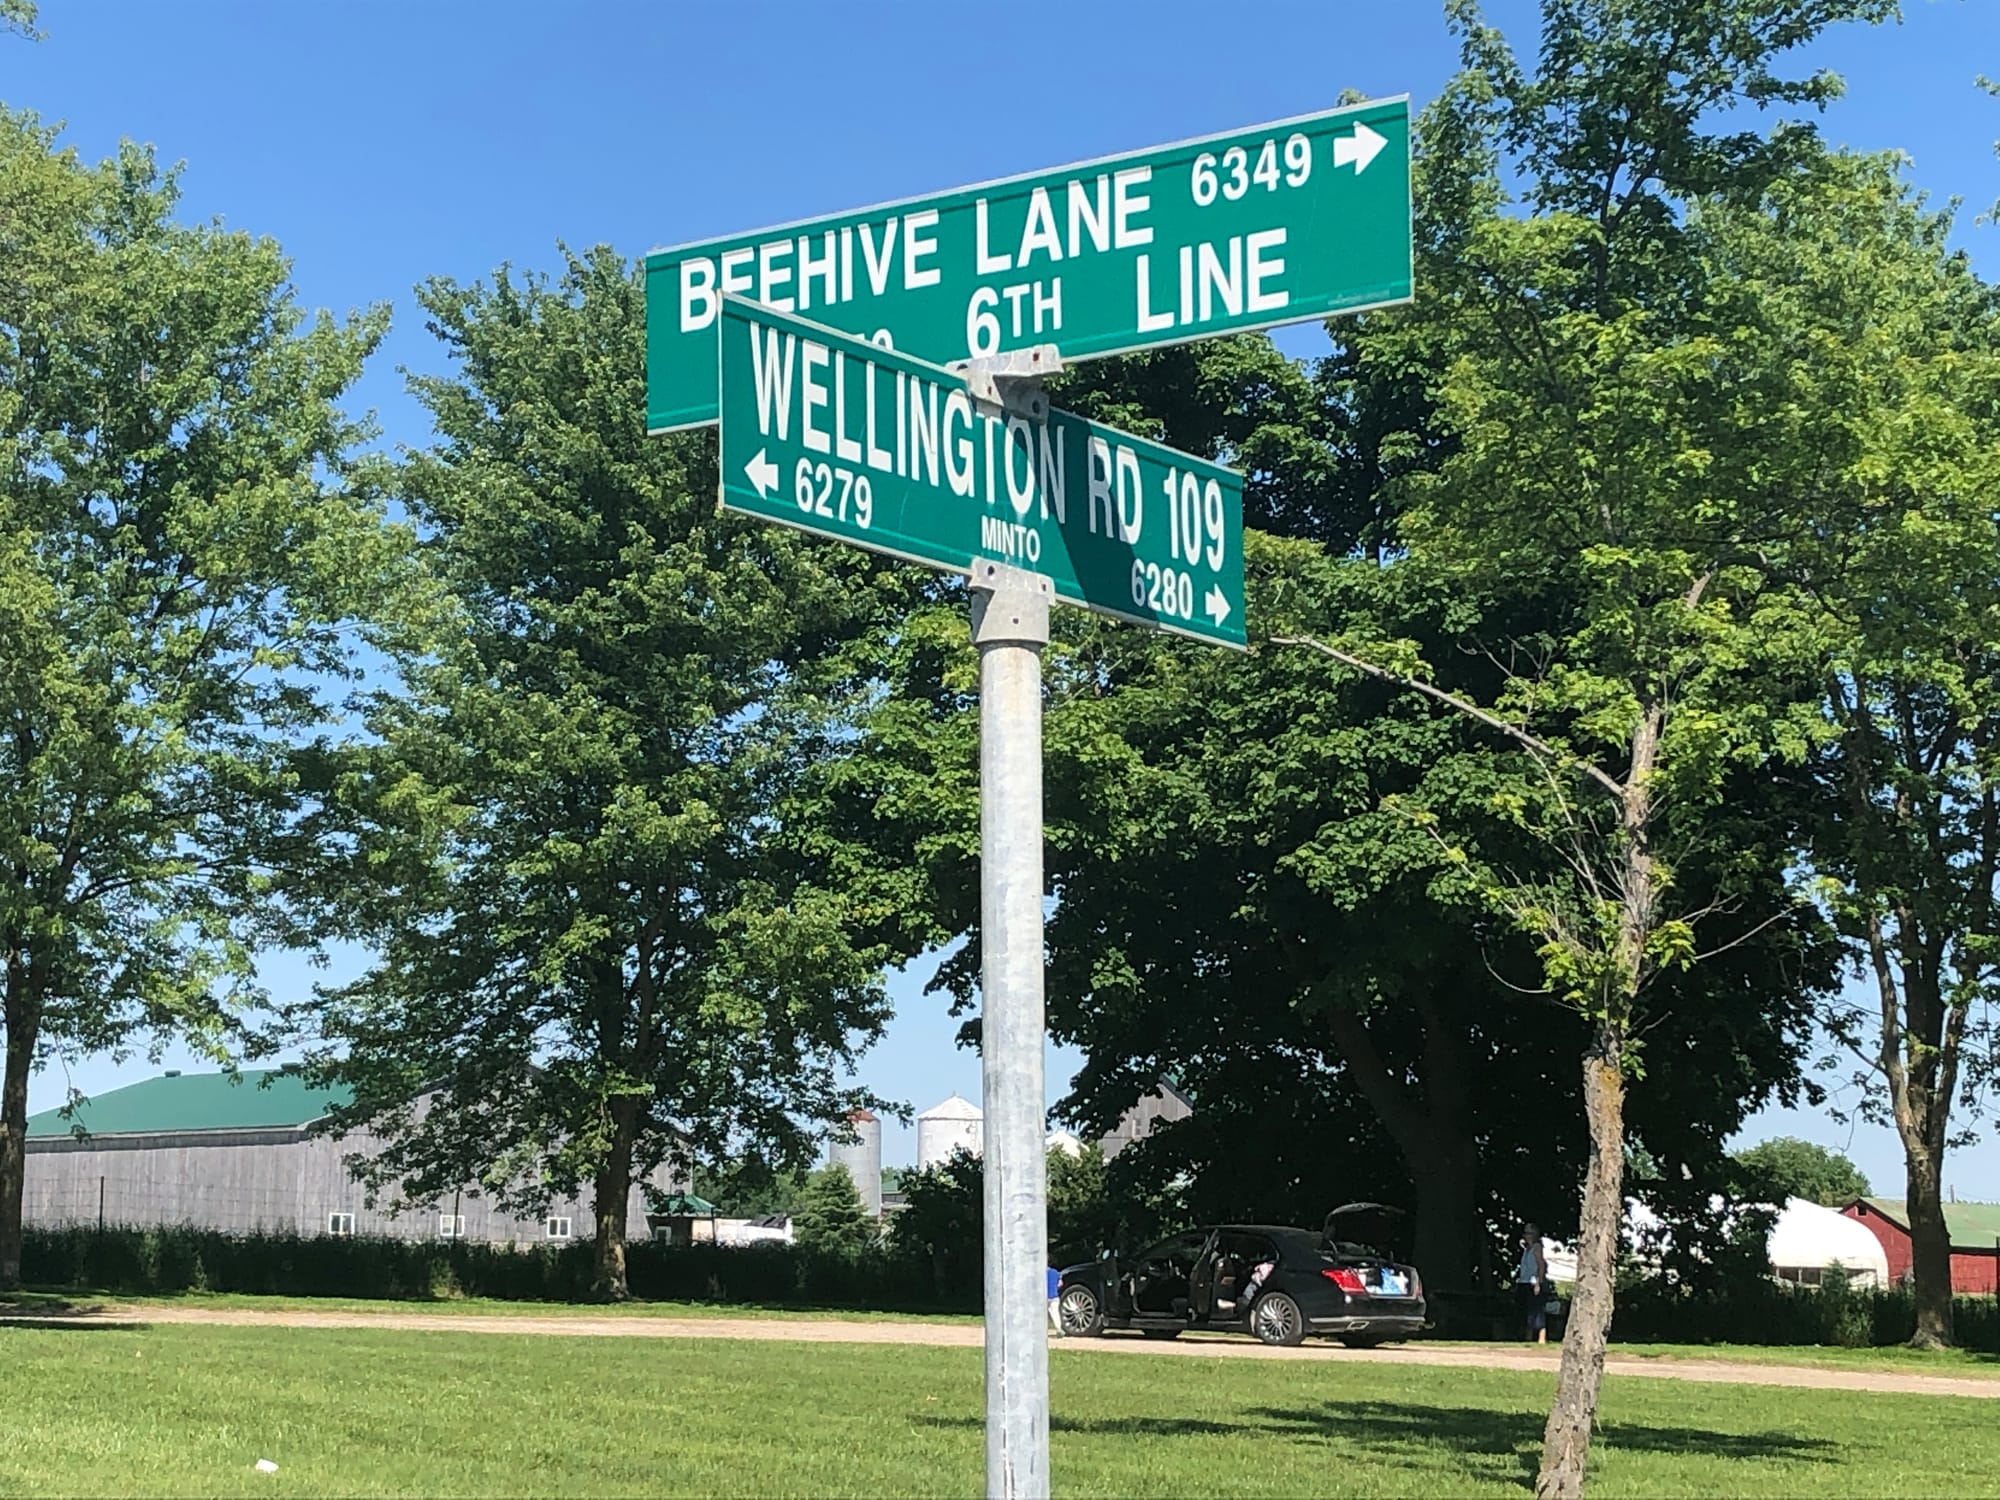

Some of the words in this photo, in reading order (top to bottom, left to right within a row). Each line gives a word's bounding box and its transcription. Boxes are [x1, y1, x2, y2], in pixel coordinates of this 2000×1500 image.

[1191, 133, 1312, 206] 6349
[680, 208, 941, 333] BEEHIVE
[975, 165, 1154, 275] LANE
[966, 277, 1062, 360] 6TH
[1136, 227, 1289, 333] LINE
[750, 319, 1066, 525] WELLINGTON
[1088, 434, 1143, 545] RD
[1163, 466, 1225, 572] 109
[795, 457, 872, 530] 6279
[981, 515, 1041, 563] MINTO
[1131, 558, 1193, 620] 6280
